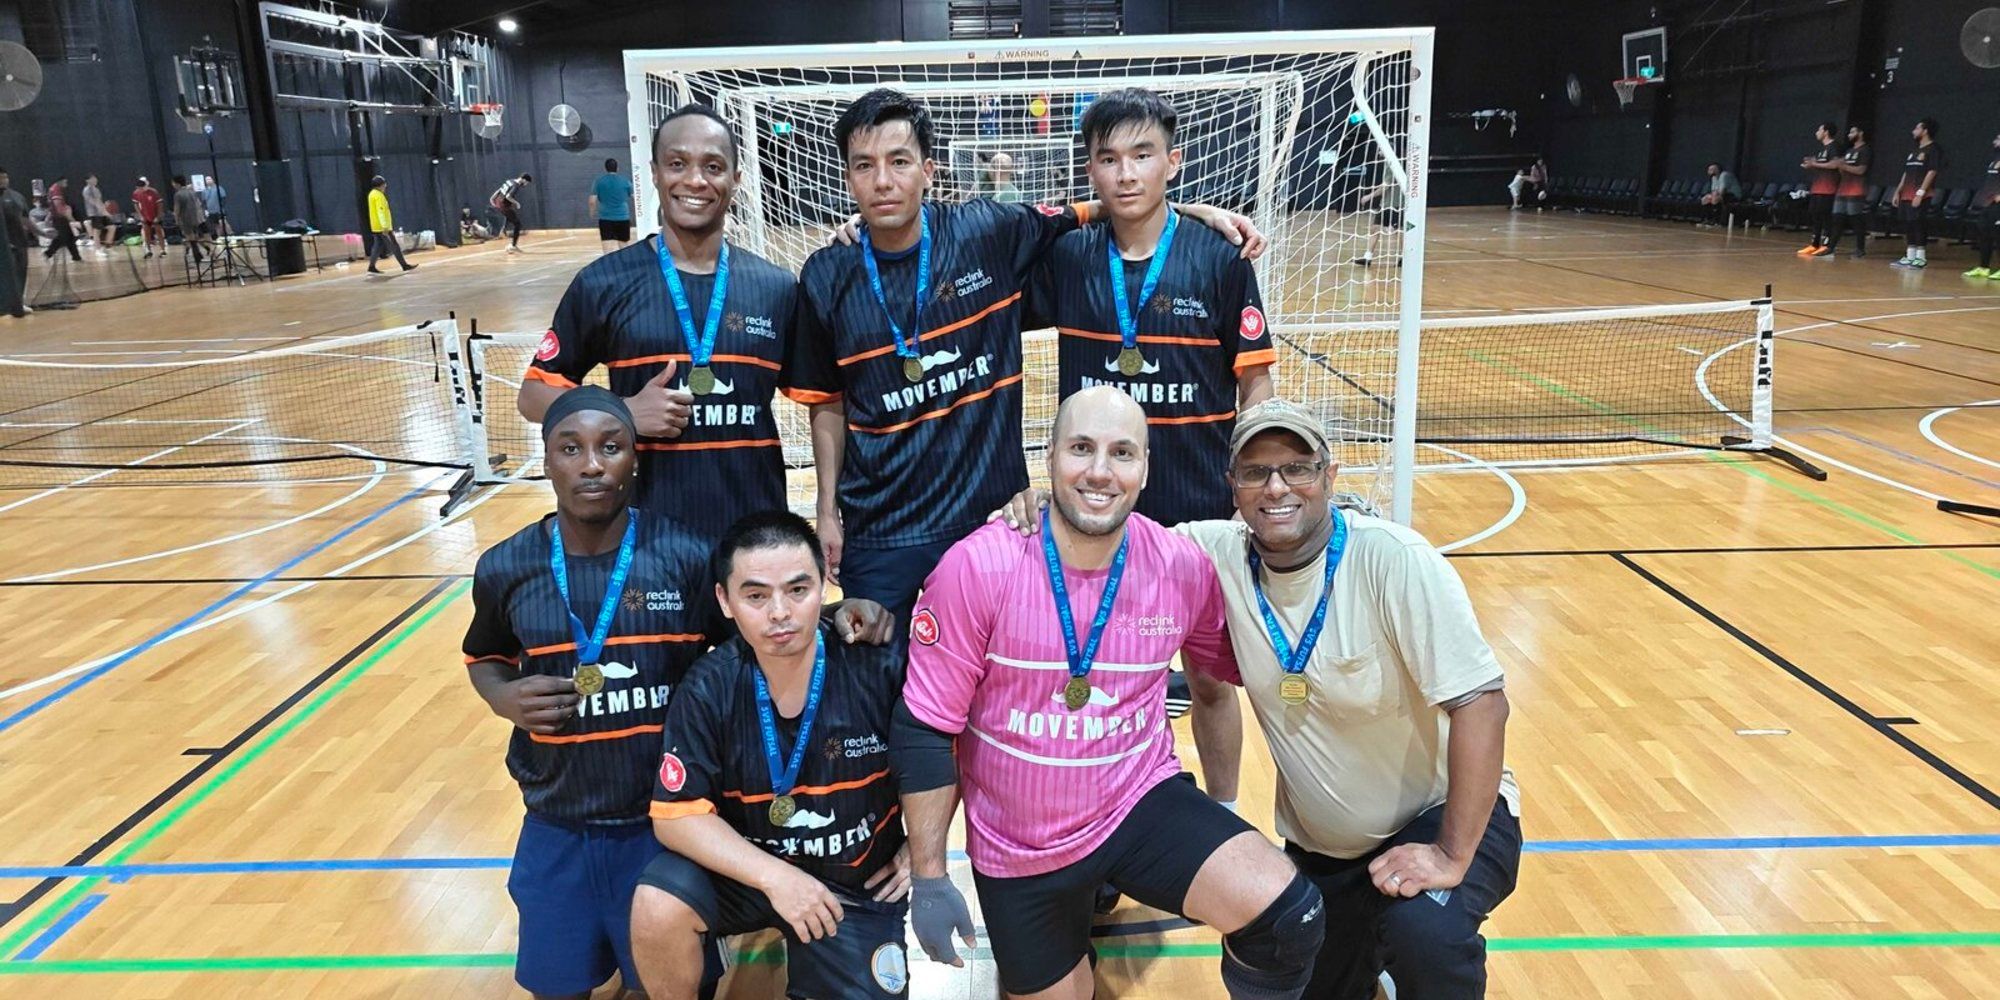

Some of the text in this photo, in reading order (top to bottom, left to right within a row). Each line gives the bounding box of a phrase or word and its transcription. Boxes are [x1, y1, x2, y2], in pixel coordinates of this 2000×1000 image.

[1005, 50, 1050, 58] WARNING
[1411, 154, 1419, 198] WARNING
[634, 173, 644, 218] WARNING
[957, 276, 993, 297] australia
[1046, 541, 1060, 573] FUTSAL
[1102, 576, 1118, 609] FUTSAL
[599, 597, 616, 627] FUTSAL
[1060, 605, 1074, 637] FUTSAL
[1138, 614, 1175, 626] reclink
[1139, 625, 1182, 636] australia
[1082, 638, 1098, 670] FUTSAL
[812, 658, 825, 691] FUTSAL
[764, 726, 778, 757] FUTSAL
[799, 720, 812, 751] FUTSAL
[844, 733, 879, 748] reclink
